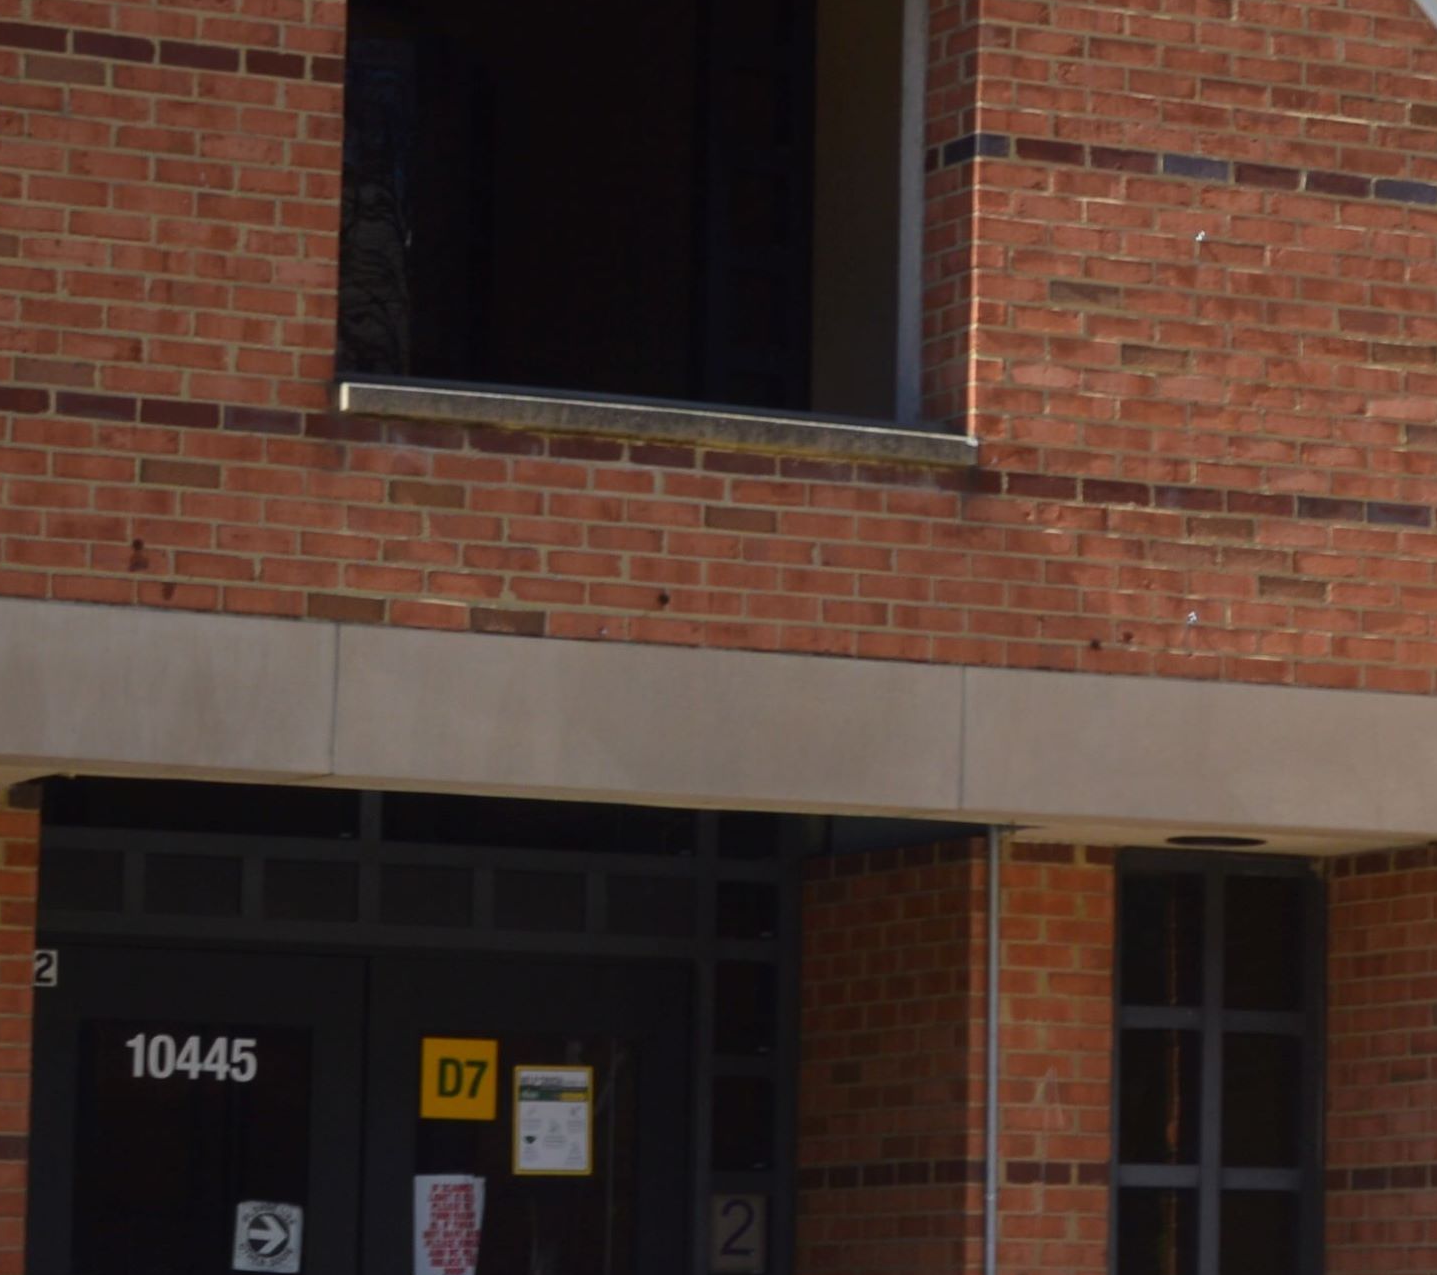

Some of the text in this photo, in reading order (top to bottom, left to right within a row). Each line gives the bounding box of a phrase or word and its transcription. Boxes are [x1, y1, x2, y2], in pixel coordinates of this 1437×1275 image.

[125, 1033, 258, 1083] 10445
[438, 1058, 489, 1099] D7
[721, 1199, 755, 1255] 2
